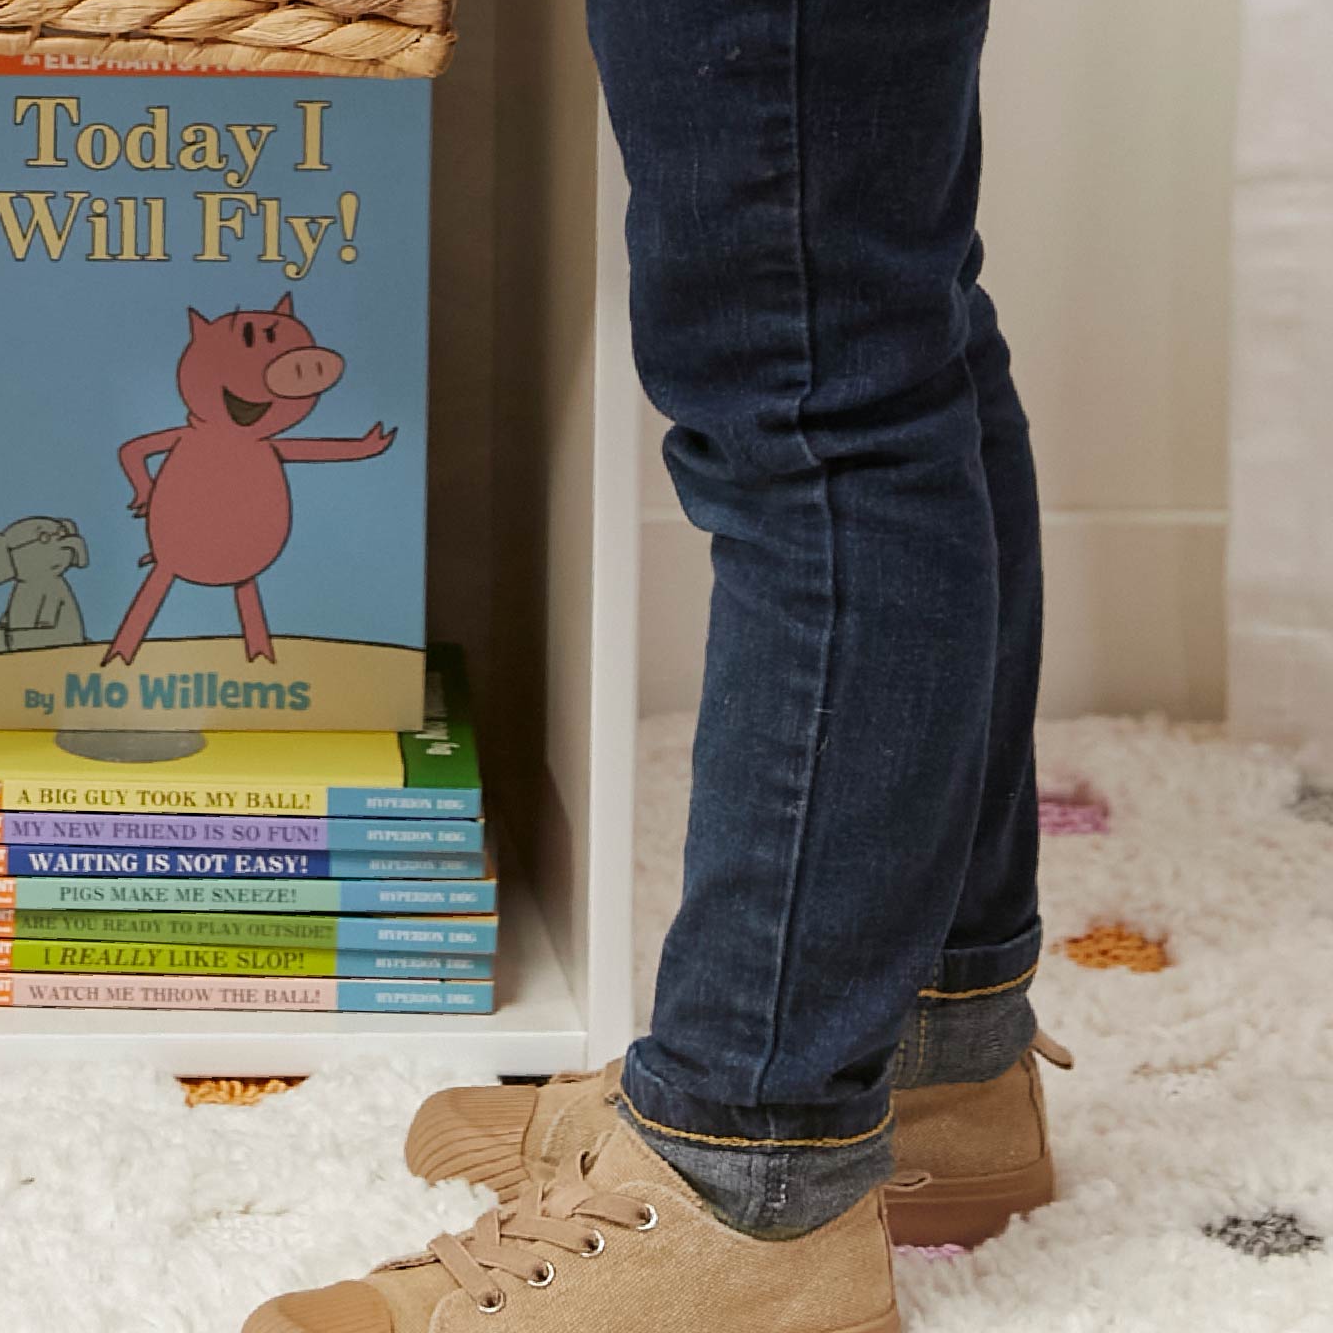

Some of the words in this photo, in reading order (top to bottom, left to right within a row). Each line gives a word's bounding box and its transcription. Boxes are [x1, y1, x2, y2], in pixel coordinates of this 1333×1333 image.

[13, 95, 277, 187] Today
[294, 100, 332, 171] I
[193, 191, 361, 280] Fly!
[24, 689, 54, 715] By
[65, 673, 129, 709] Mo
[139, 673, 312, 711] Willems
[18, 789, 31, 805] A
[41, 790, 76, 806] BIG
[85, 790, 127, 807] GUY
[137, 791, 196, 808] TOOK
[205, 792, 236, 808] MY
[247, 793, 310, 809] BALL!
[29, 854, 137, 872] WAITING
[147, 854, 170, 873] IS
[177, 855, 227, 873] NOT
[235, 856, 307, 874] EASY!
[61, 887, 104, 902] PIGS
[112, 887, 168, 903] MAKE
[176, 888, 204, 903] ME
[212, 888, 296, 904] SNEEZE!
[60, 948, 161, 967] REALLY
[170, 950, 227, 969] LIKE
[237, 951, 305, 970] SLOP!
